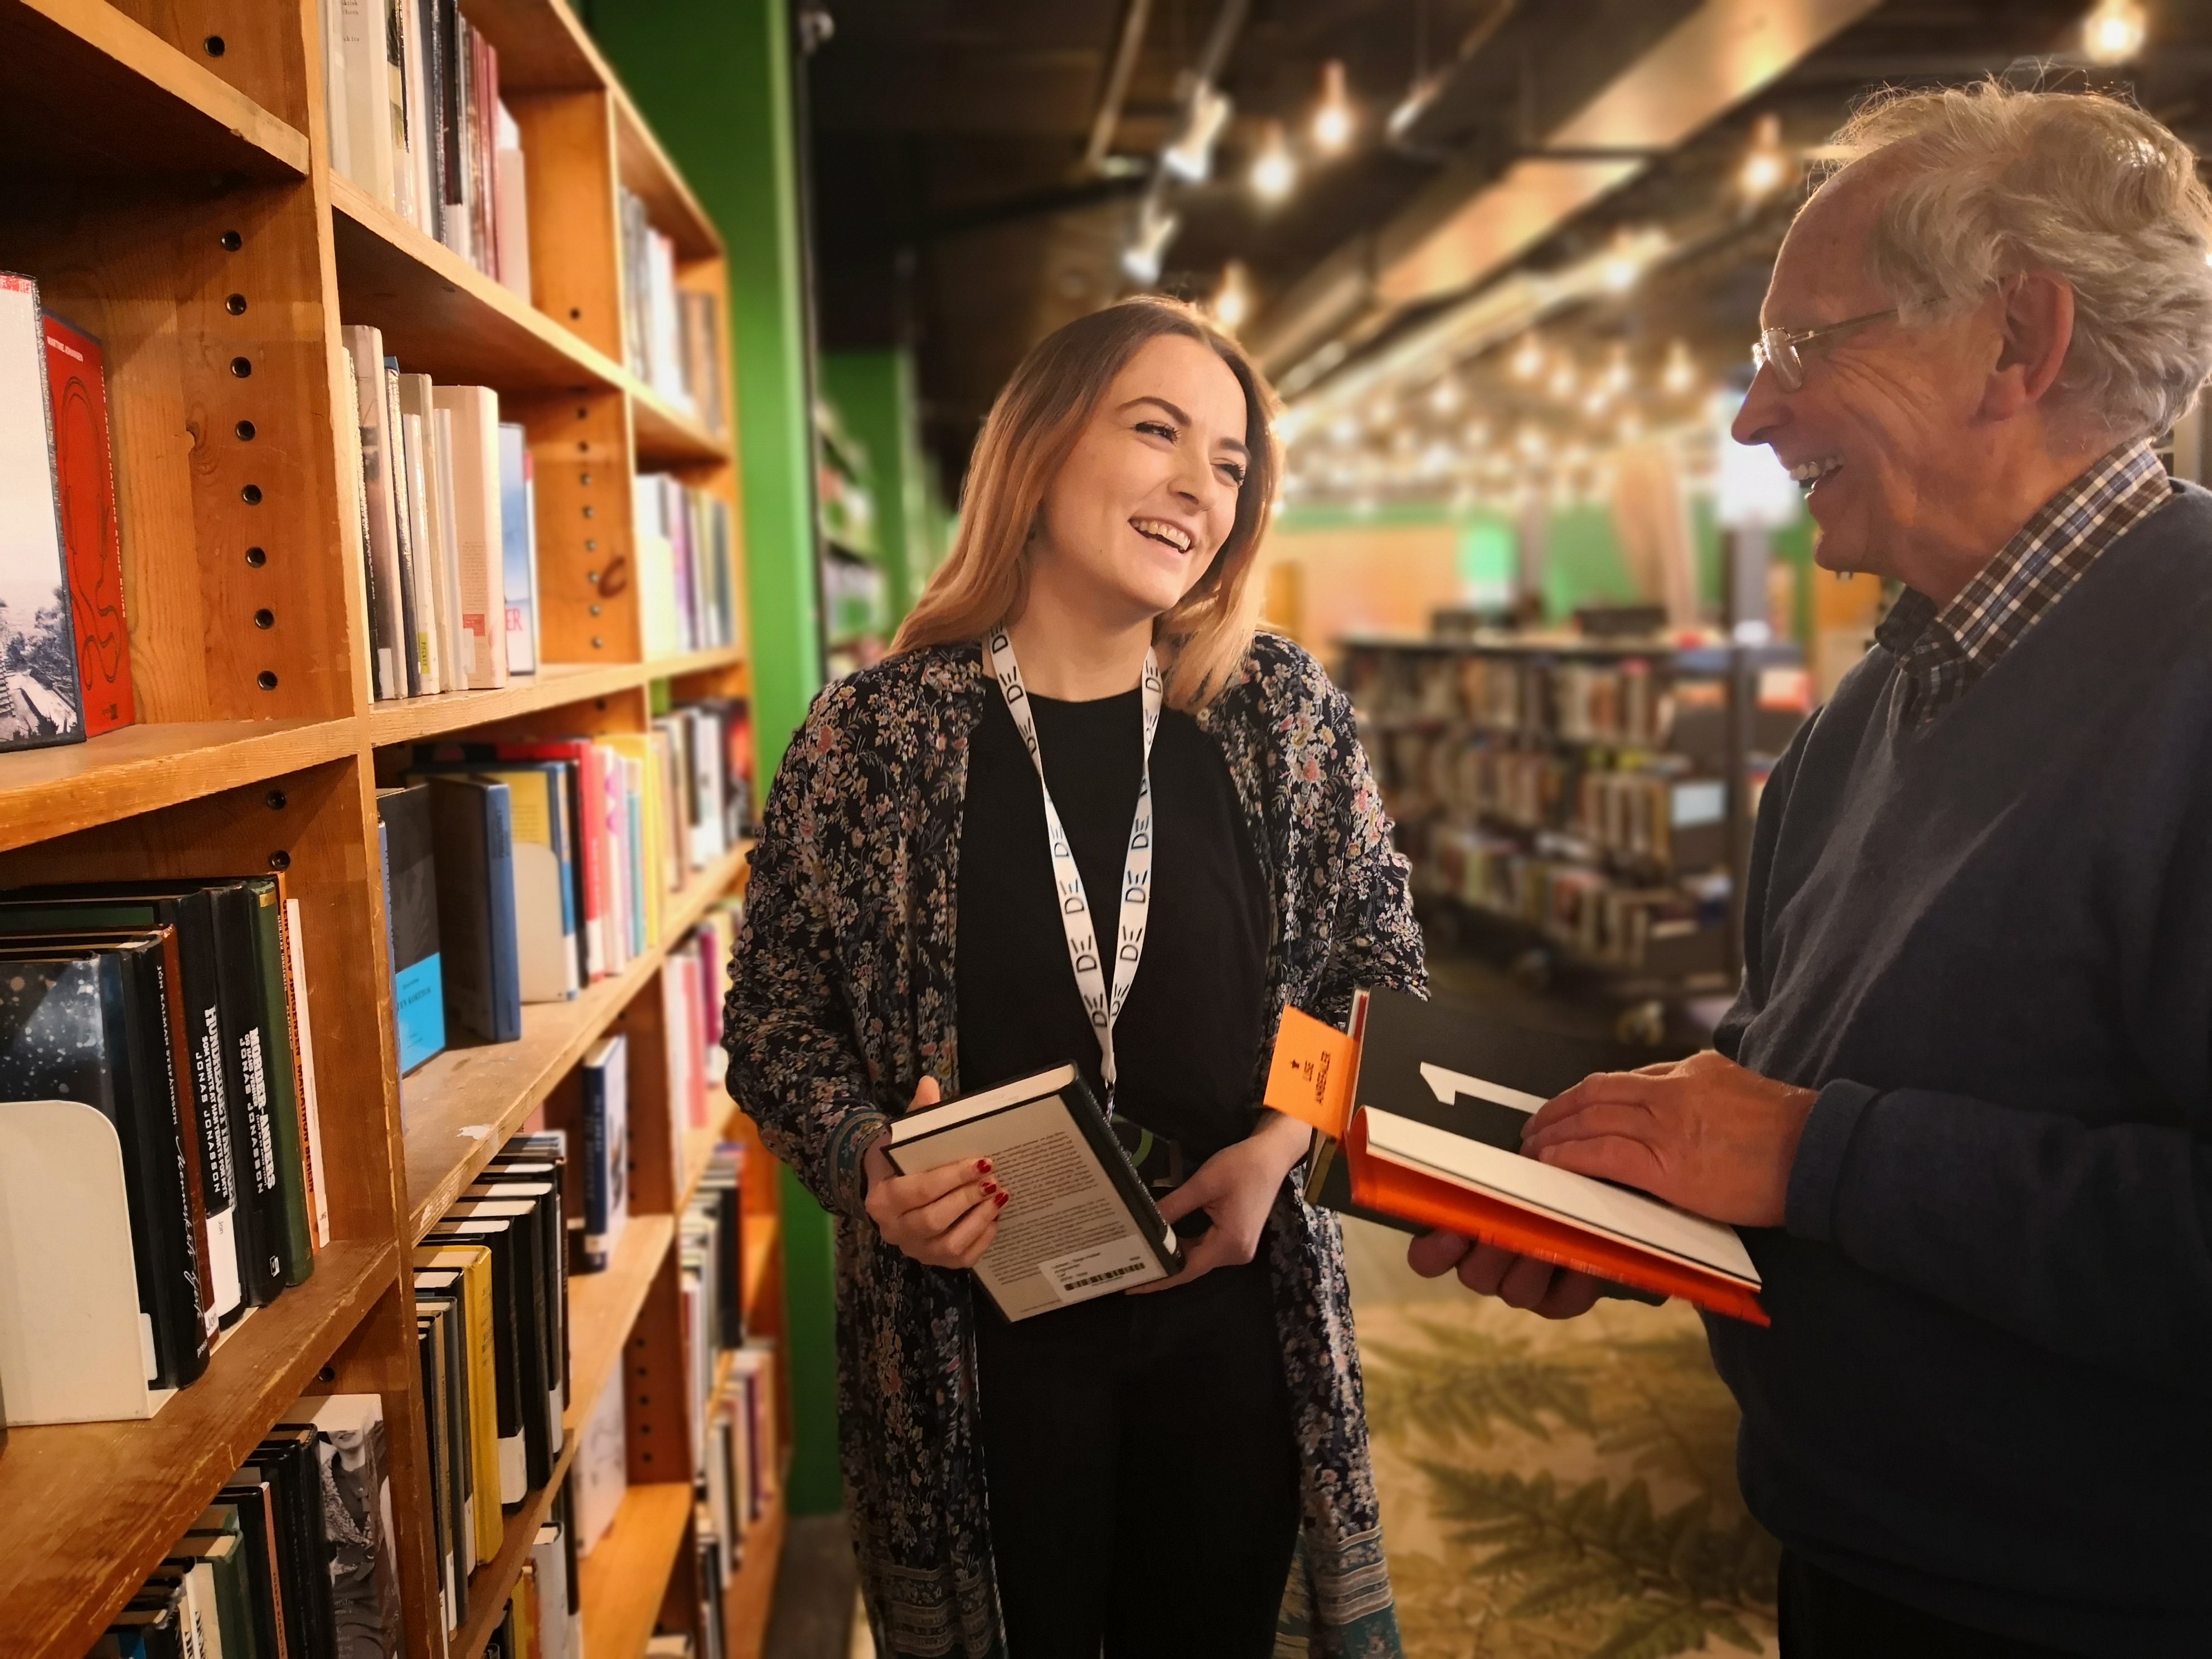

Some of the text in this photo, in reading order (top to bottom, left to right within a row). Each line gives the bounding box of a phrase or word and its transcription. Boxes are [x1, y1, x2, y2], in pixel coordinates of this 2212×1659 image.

[159, 993, 169, 1045] KALMAN
[201, 1036, 210, 1056] SOM
[204, 1056, 215, 1092] TENKTE
[249, 1073, 258, 1107] VENNER
[209, 1092, 216, 1103] AT
[248, 1027, 276, 1189] MORDER-ANDERS
[195, 1052, 220, 1193] JONAS JONASSON
[239, 1038, 264, 1194] JONAS JONASSON
[296, 1063, 309, 1142] MARATHON
[304, 1147, 314, 1194] BERLIN
[214, 1124, 223, 1158] TENKTE
[206, 1312, 218, 1331] Jon
[197, 1339, 208, 1359] press
